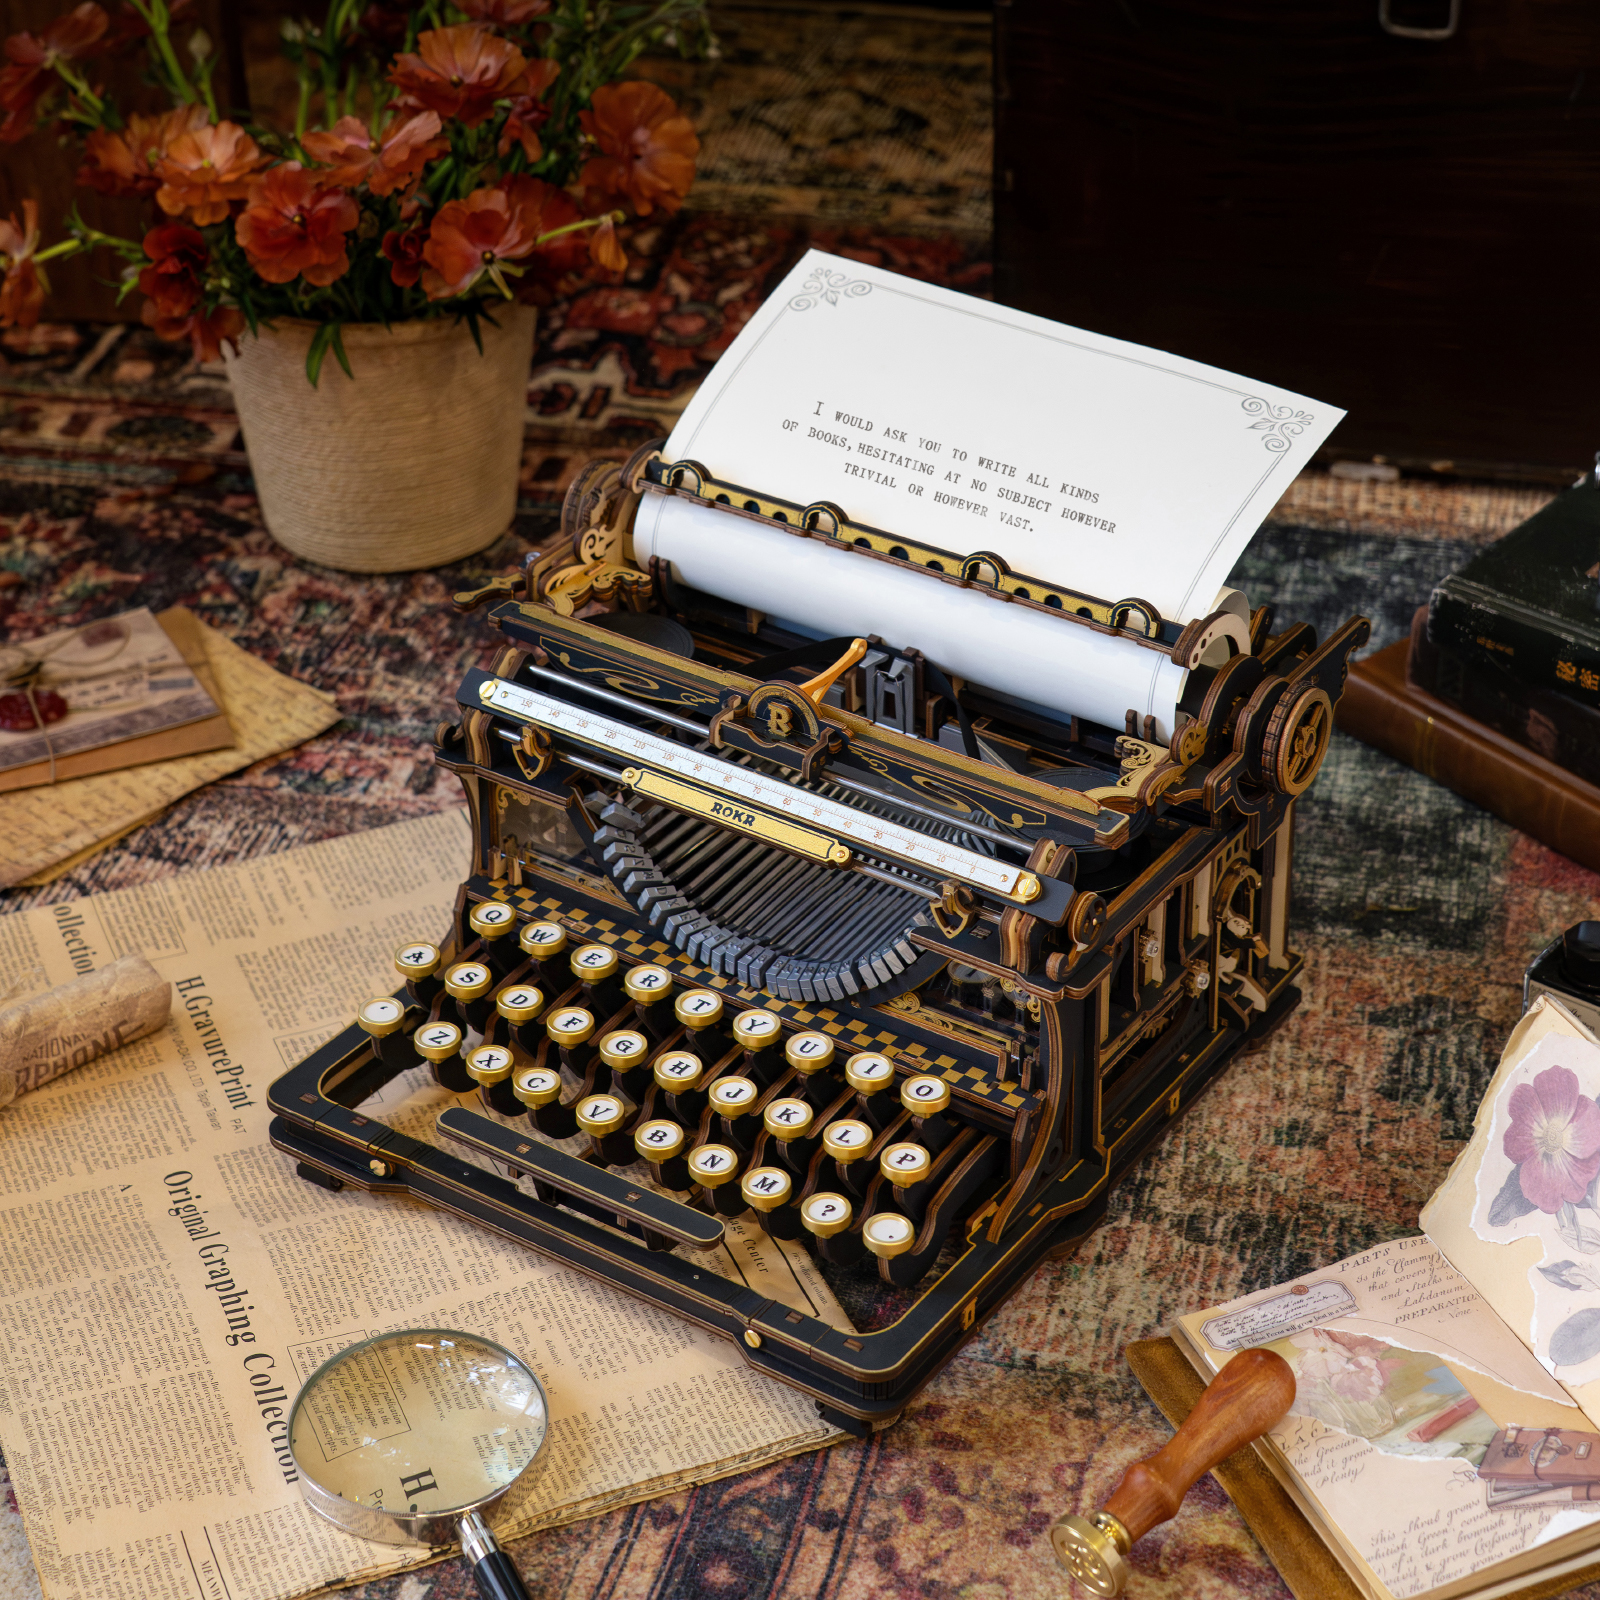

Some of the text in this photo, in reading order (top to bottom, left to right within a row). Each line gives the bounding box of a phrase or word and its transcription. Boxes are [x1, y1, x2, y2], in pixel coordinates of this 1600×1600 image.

[813, 400, 1100, 504] I WOULD ASK YOU TO WRITE ALL KINDS
[782, 419, 799, 432] OF
[944, 470, 962, 484] AT
[970, 478, 988, 492] NO
[997, 487, 1052, 512] SUBJECT
[1060, 508, 1117, 534] HOWEVER
[844, 462, 1034, 532] TRIVIAL OR HOWEVER VAST.
[520, 700, 533, 708] 150
[548, 710, 560, 718] 140
[576, 720, 589, 729] 130
[604, 730, 616, 740] 120
[634, 740, 646, 749] 110
[662, 752, 674, 761] 100
[693, 764, 703, 772] 90
[723, 775, 732, 783] 80
[753, 786, 762, 794] 70
[782, 798, 792, 806] 60
[812, 808, 822, 817] 50
[843, 821, 852, 829] 40
[874, 831, 883, 840] 30
[905, 842, 915, 851] 20
[936, 854, 946, 862] 10
[711, 801, 756, 826] ROKR
[485, 910, 502, 922] Q
[53, 904, 97, 976] ollectio
[530, 929, 554, 943] W
[404, 951, 424, 964] A
[583, 952, 603, 965] E
[459, 972, 479, 983] S
[639, 974, 659, 988] R
[509, 994, 528, 1005] D
[693, 998, 711, 1012] T
[563, 1016, 583, 1028] F
[746, 1018, 768, 1031] Y
[174, 975, 257, 1110] H.GravurePrint
[428, 1030, 450, 1045] Z
[615, 1040, 634, 1054] G
[799, 1040, 819, 1054] U
[476, 1054, 500, 1068] X
[668, 1061, 691, 1076] H
[864, 1063, 879, 1075] I
[527, 1077, 547, 1089] C
[725, 1088, 745, 1099] J
[915, 1085, 934, 1097] O
[196, 1088, 211, 1108] Taipei
[205, 1106, 222, 1130] Taiwan
[589, 1104, 612, 1119] V
[777, 1107, 797, 1123] K
[230, 1117, 247, 1133] PAT
[646, 1129, 668, 1143] B
[835, 1129, 851, 1143] L
[701, 1153, 724, 1168] N
[896, 1153, 916, 1165] P
[753, 1176, 779, 1193] M
[821, 1204, 836, 1216] ?
[162, 1170, 221, 1241] Original
[197, 1243, 256, 1347] Graphing
[743, 1239, 769, 1273] Center
[1338, 1247, 1390, 1273] PARTS
[1371, 1265, 1386, 1279] the
[1367, 1268, 1426, 1292] that covers
[1380, 1287, 1400, 1301] and
[1404, 1273, 1442, 1293] Stalks
[305, 1346, 317, 1370] editing.
[354, 1382, 362, 1392] the
[366, 1354, 401, 1425] intended for publication
[333, 1393, 345, 1404] and
[338, 1404, 347, 1414] are
[344, 1389, 357, 1412] address.
[354, 1412, 364, 1425] Let-
[324, 1402, 349, 1446] responsible for
[342, 1415, 357, 1436] subject
[380, 1415, 390, 1425] the
[352, 1437, 360, 1445] to
[507, 1440, 519, 1454] But
[471, 1435, 497, 1484] mental effort
[1342, 1447, 1374, 1470] grows
[1316, 1462, 1365, 1488] Plenty
[1371, 1499, 1480, 1546] This Shrub grows
[1420, 1538, 1448, 1558] dark
[1458, 1515, 1505, 1544] brownish
[1440, 1549, 1469, 1574] grow
[1408, 1578, 1424, 1594] the
[1470, 1552, 1504, 1572] grows
